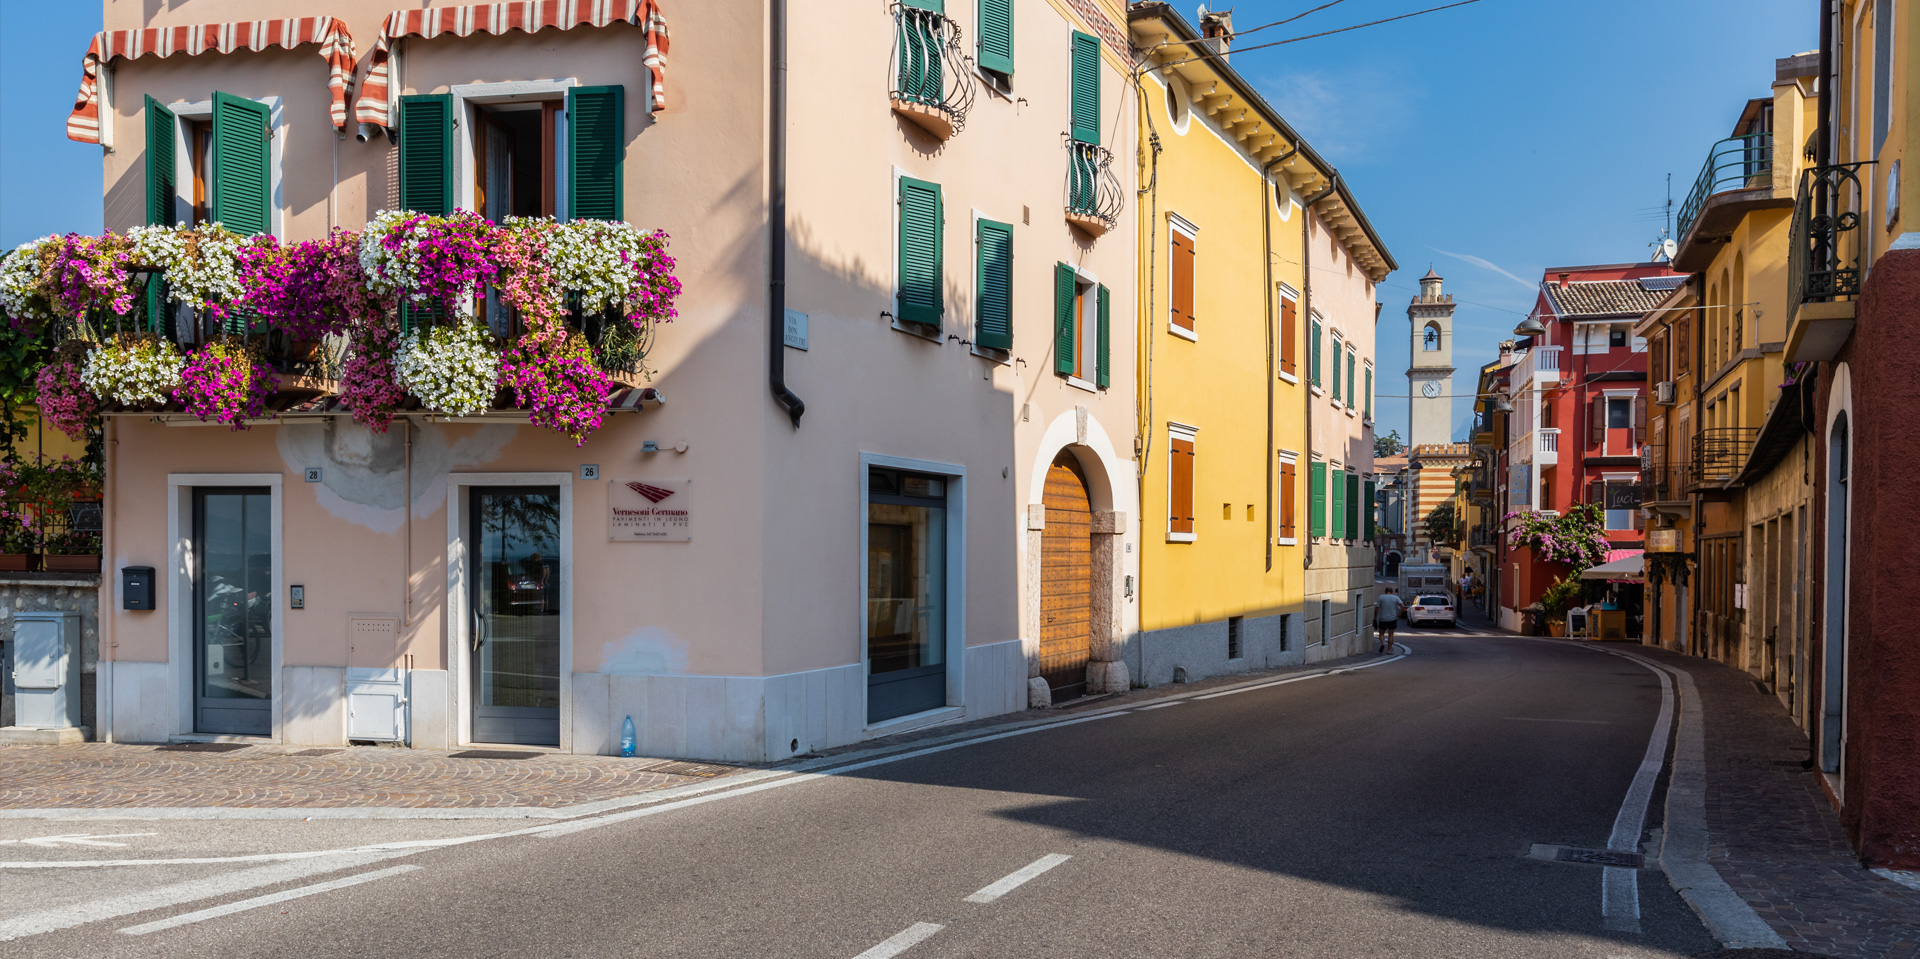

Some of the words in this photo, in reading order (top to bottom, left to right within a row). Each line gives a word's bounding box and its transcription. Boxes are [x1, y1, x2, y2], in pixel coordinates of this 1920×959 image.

[788, 316, 797, 325] VIA
[788, 326, 797, 335] DON
[309, 470, 318, 480] 28
[585, 467, 594, 477] 26
[612, 507, 650, 516] Vernesoni
[651, 507, 688, 516] Germano
